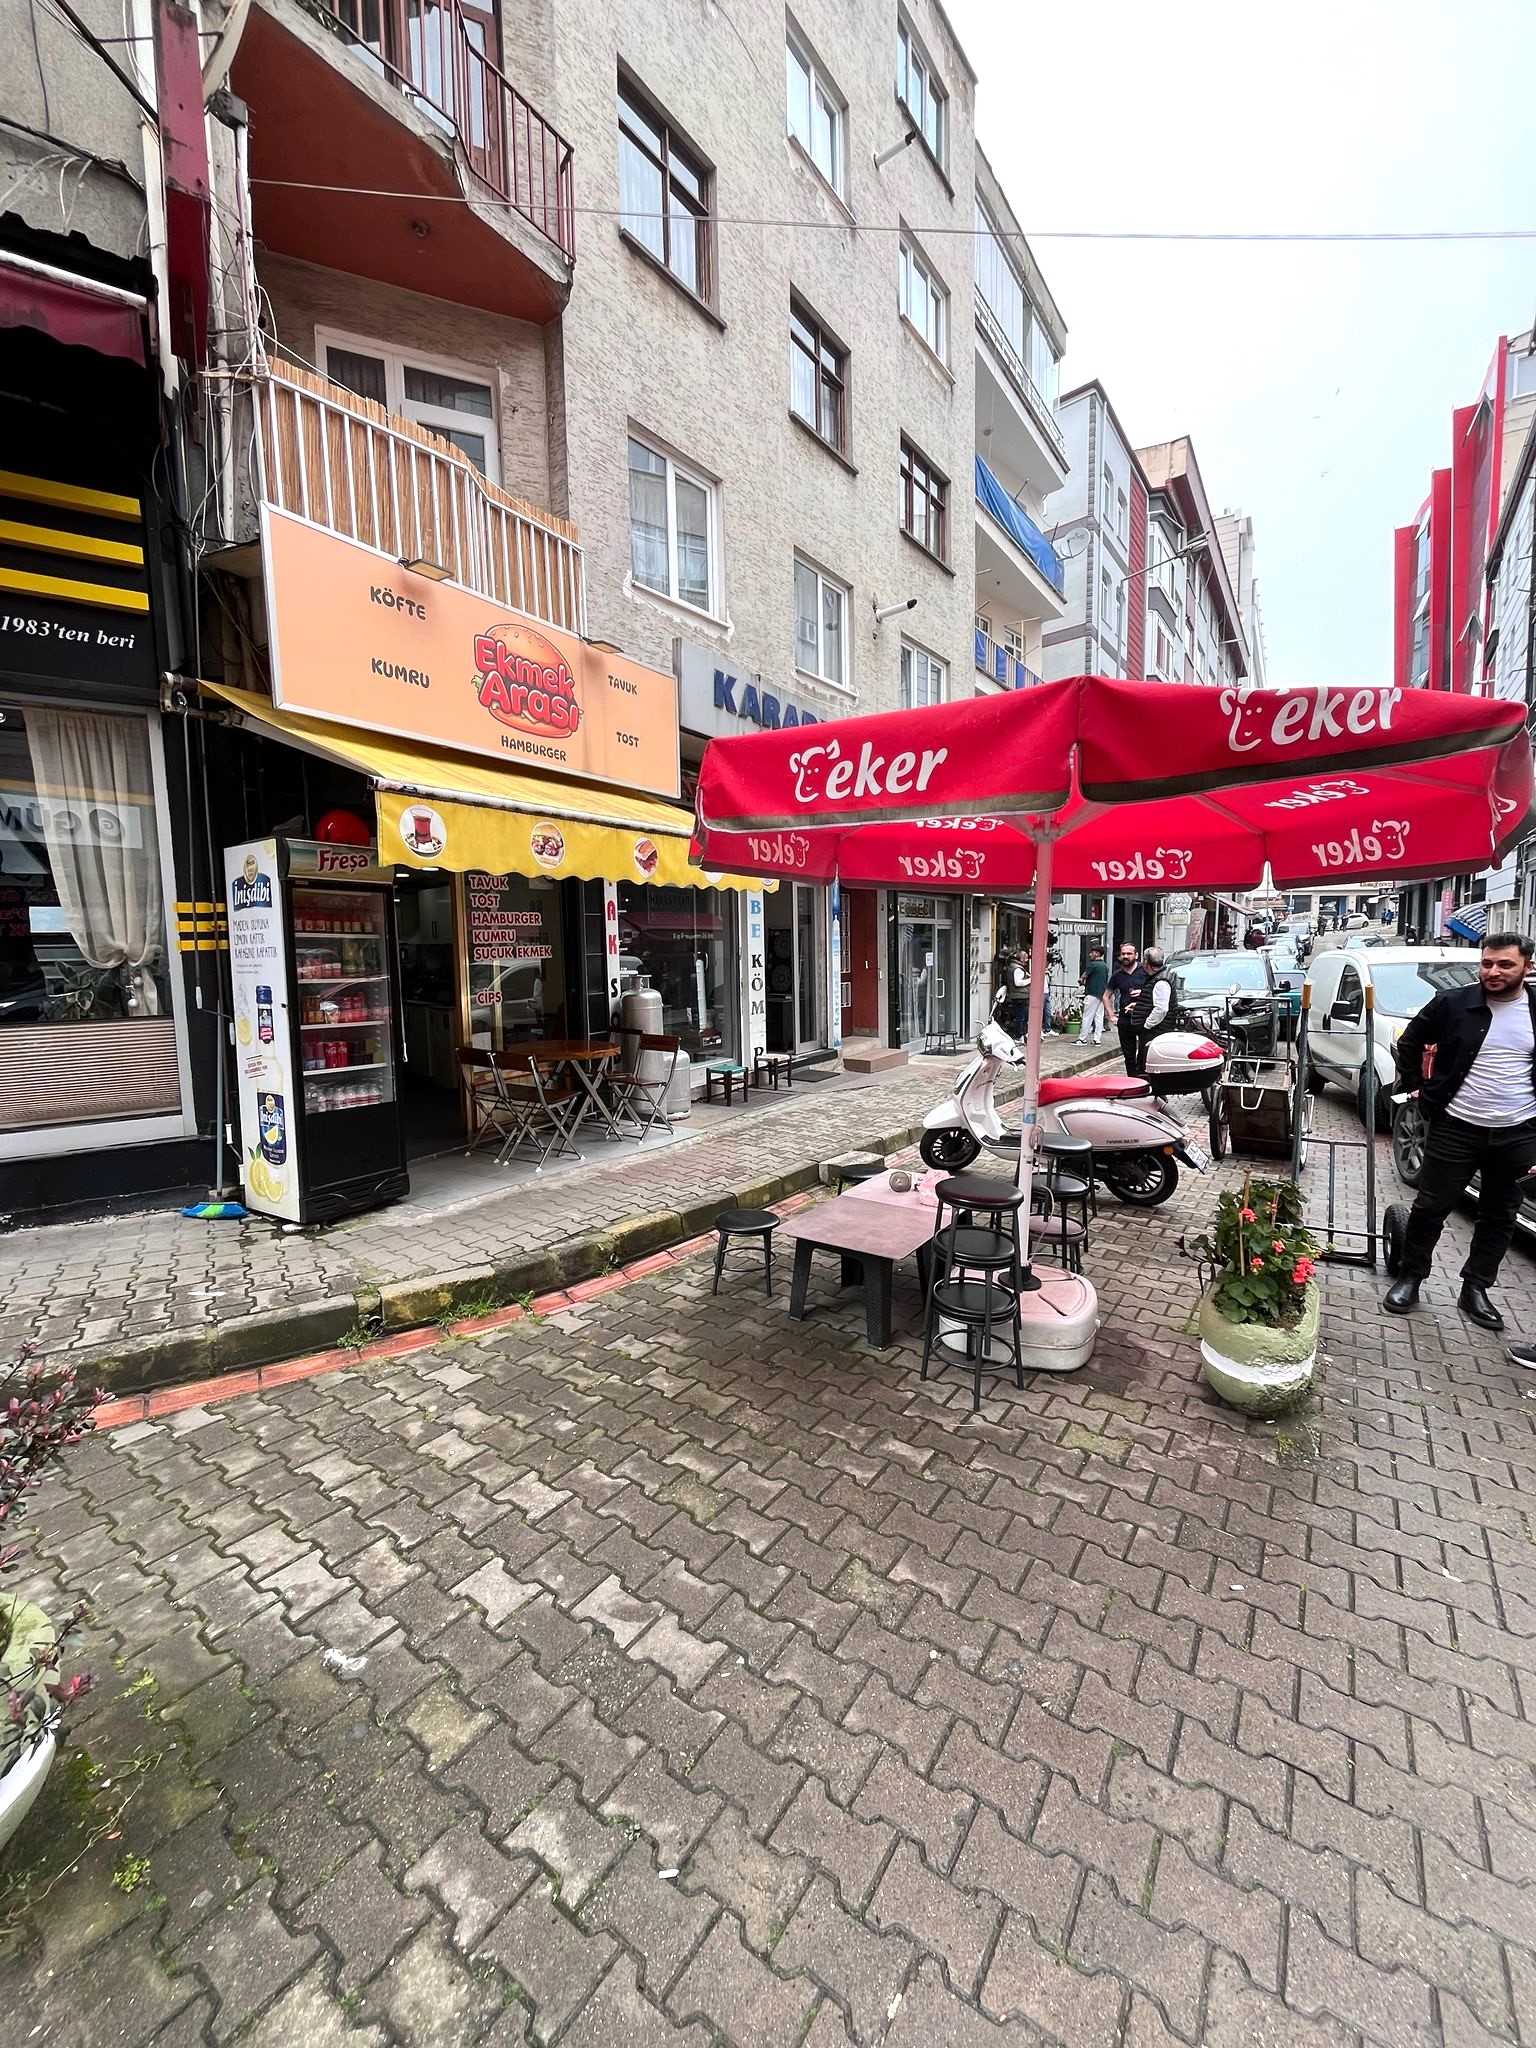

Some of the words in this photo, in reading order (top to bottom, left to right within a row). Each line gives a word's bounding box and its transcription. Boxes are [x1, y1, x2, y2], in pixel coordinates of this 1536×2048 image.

[370, 586, 426, 620] KÖFTE
[1, 615, 90, 642] 1983'ten
[96, 630, 136, 649] beri
[371, 658, 430, 688] KUMRU
[474, 634, 575, 698] Ekmek
[608, 675, 638, 695] TAVUK
[479, 671, 580, 732] Arası
[501, 735, 567, 761] HAMBURGER
[616, 731, 639, 747] TOST
[469, 876, 508, 889] TAVUK
[471, 894, 499, 907] TOST
[472, 913, 541, 926] HAMBURGER
[473, 930, 516, 943] KUMRU
[475, 947, 513, 960] SUCUK
[516, 946, 552, 959] EKMEK
[477, 988, 502, 1005] CİPS
